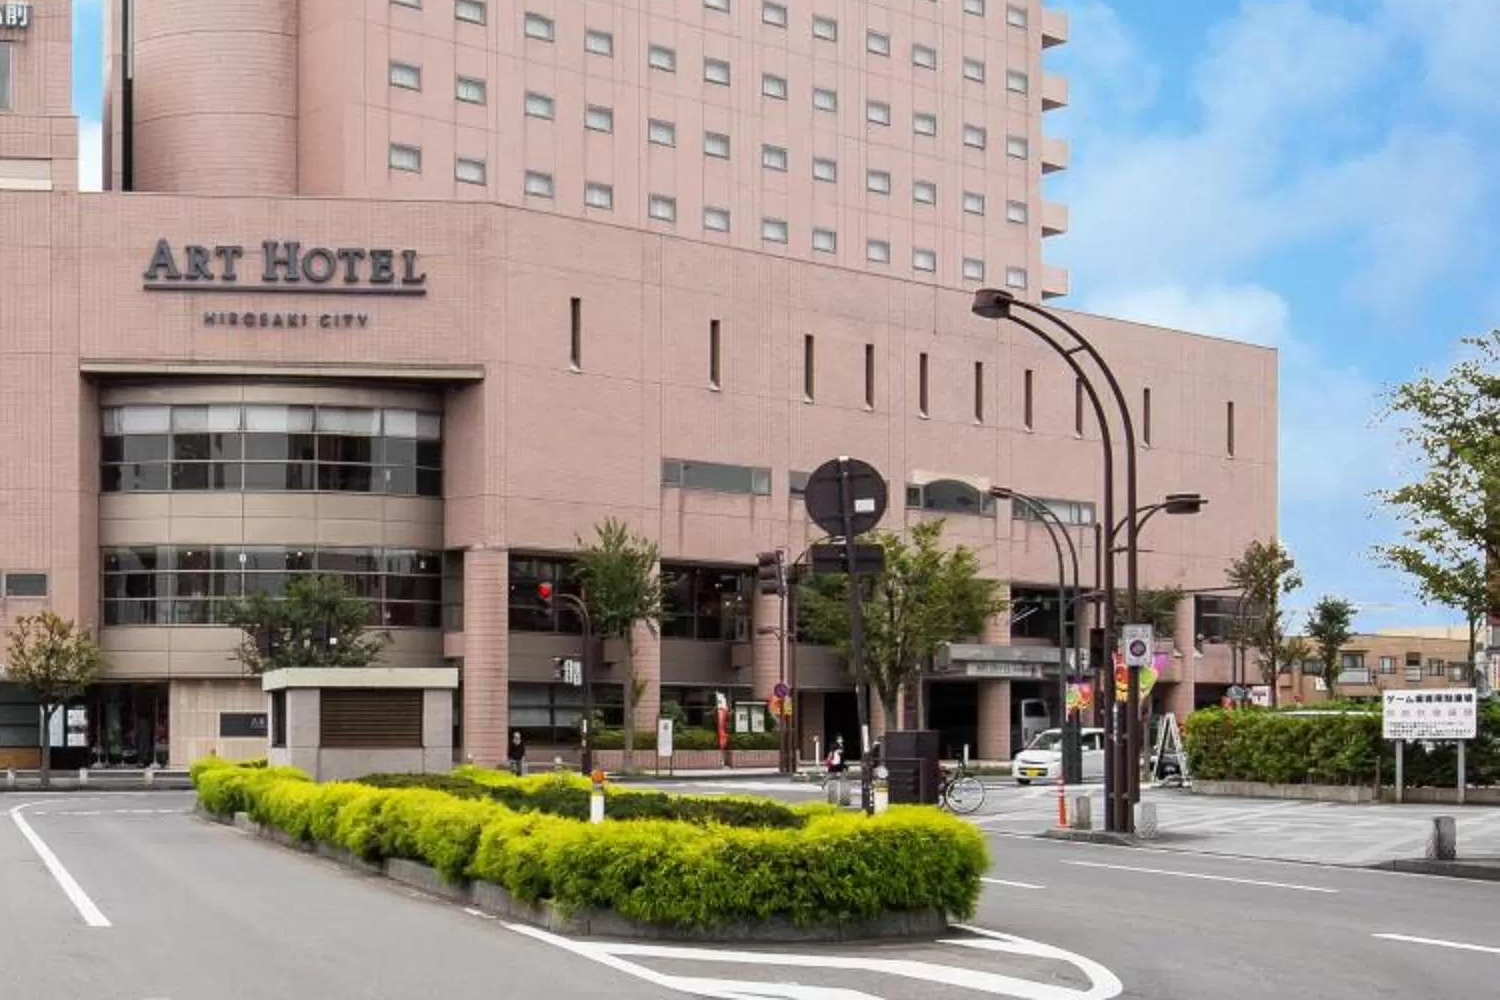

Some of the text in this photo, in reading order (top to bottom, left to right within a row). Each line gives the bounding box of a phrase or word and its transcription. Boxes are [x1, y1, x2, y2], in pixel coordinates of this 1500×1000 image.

[143, 237, 427, 285] ART HOTEL
[203, 311, 369, 329] HIROSAKI CITY
